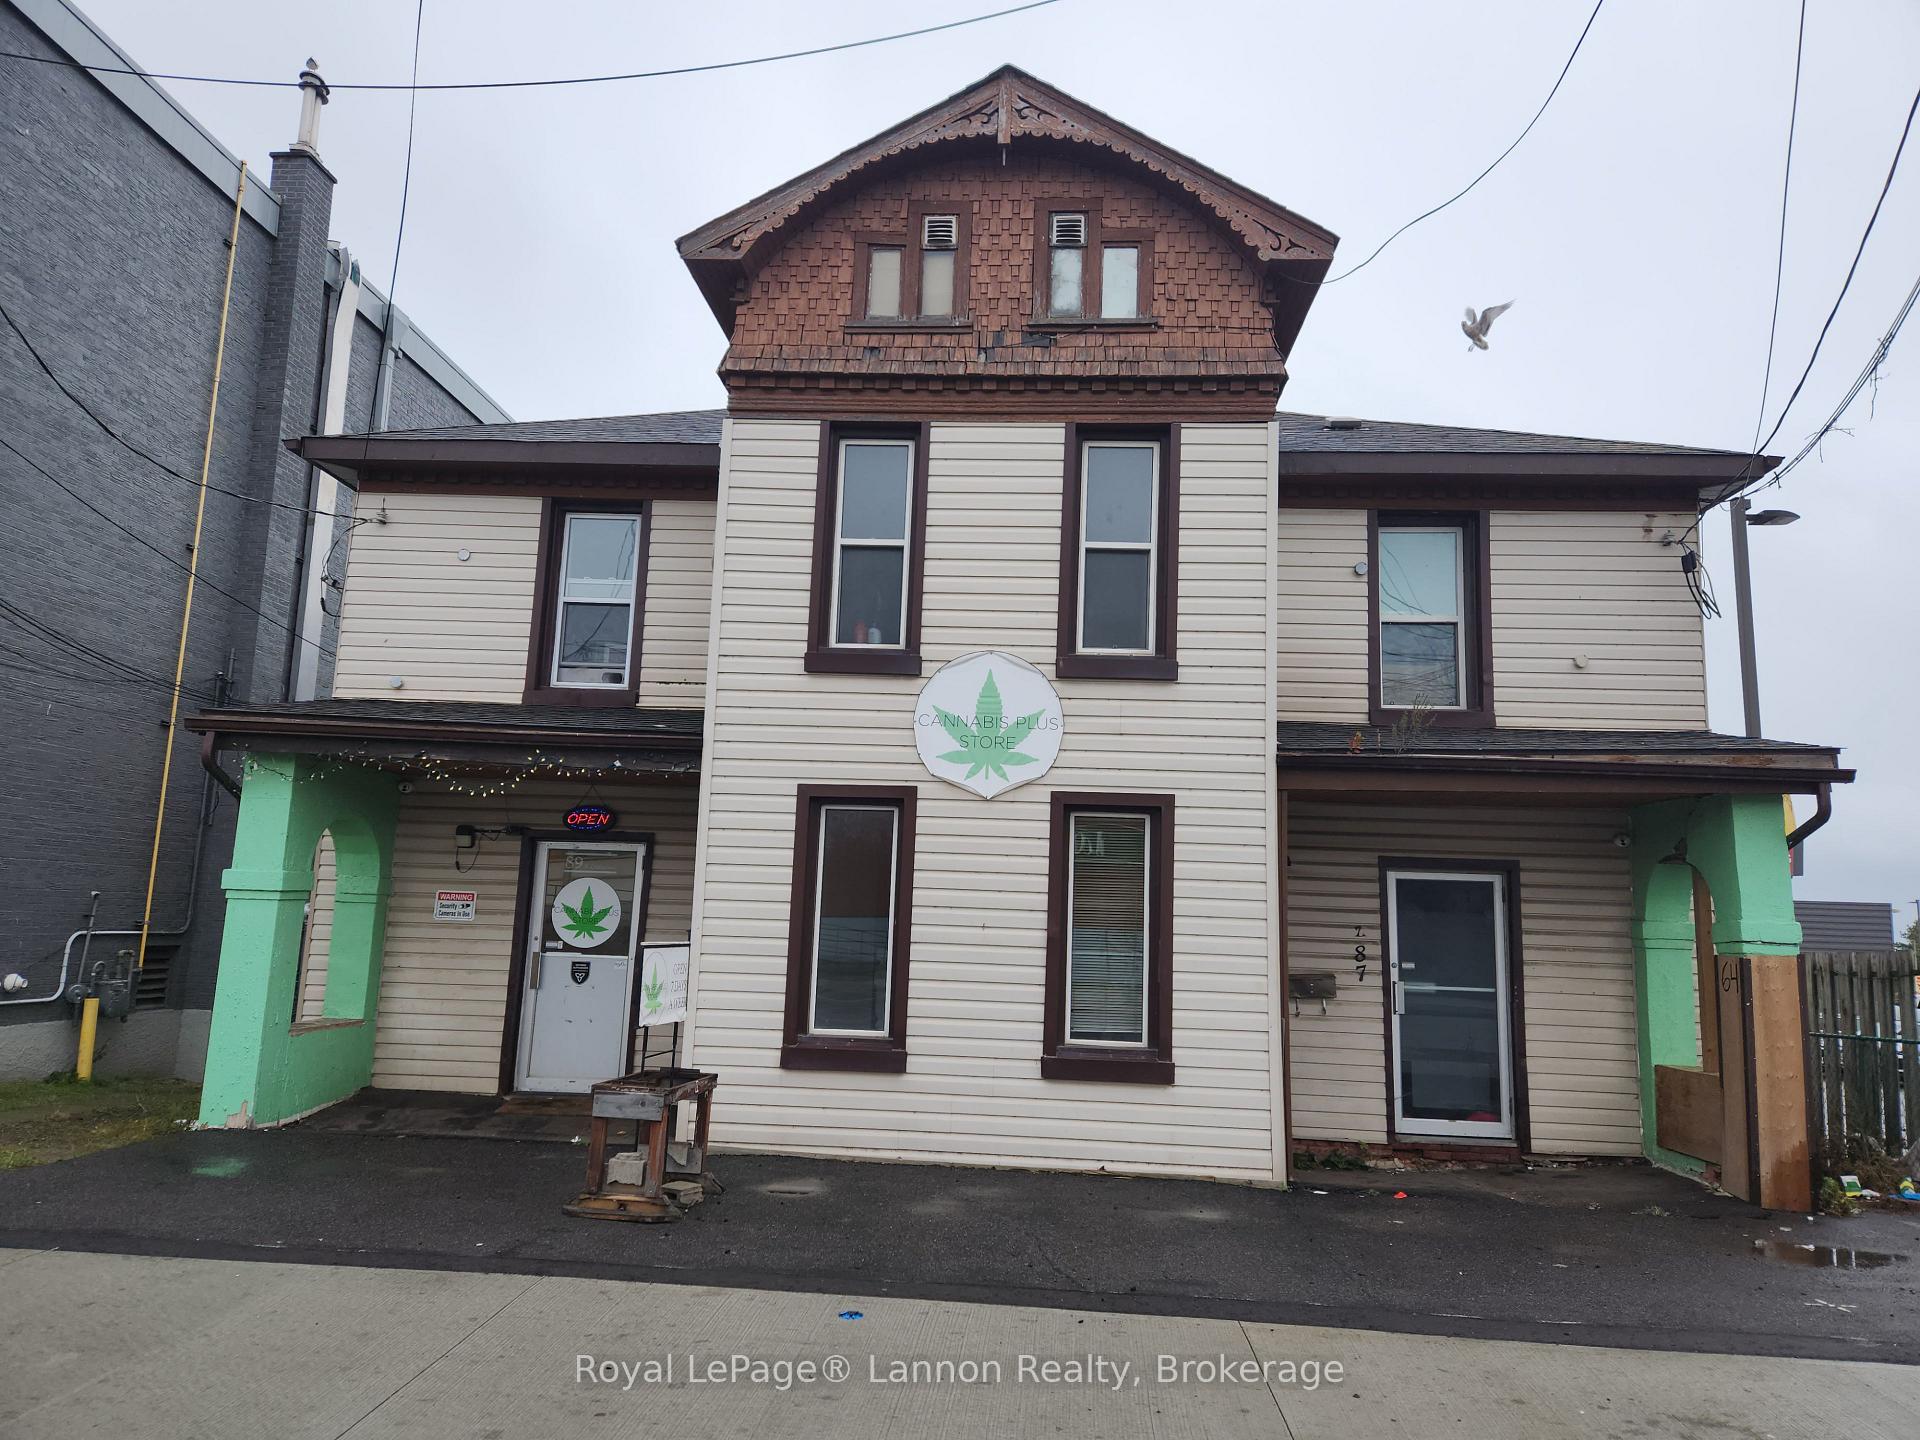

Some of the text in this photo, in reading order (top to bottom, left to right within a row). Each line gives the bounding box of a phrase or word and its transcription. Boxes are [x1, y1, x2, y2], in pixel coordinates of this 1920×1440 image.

[918, 713, 1059, 731] CANNABIS PLUS
[959, 734, 1017, 750] STORE
[567, 812, 610, 825] OPEN
[440, 893, 473, 901] WARNING
[439, 902, 458, 910] Security
[1721, 960, 1739, 995] 64
